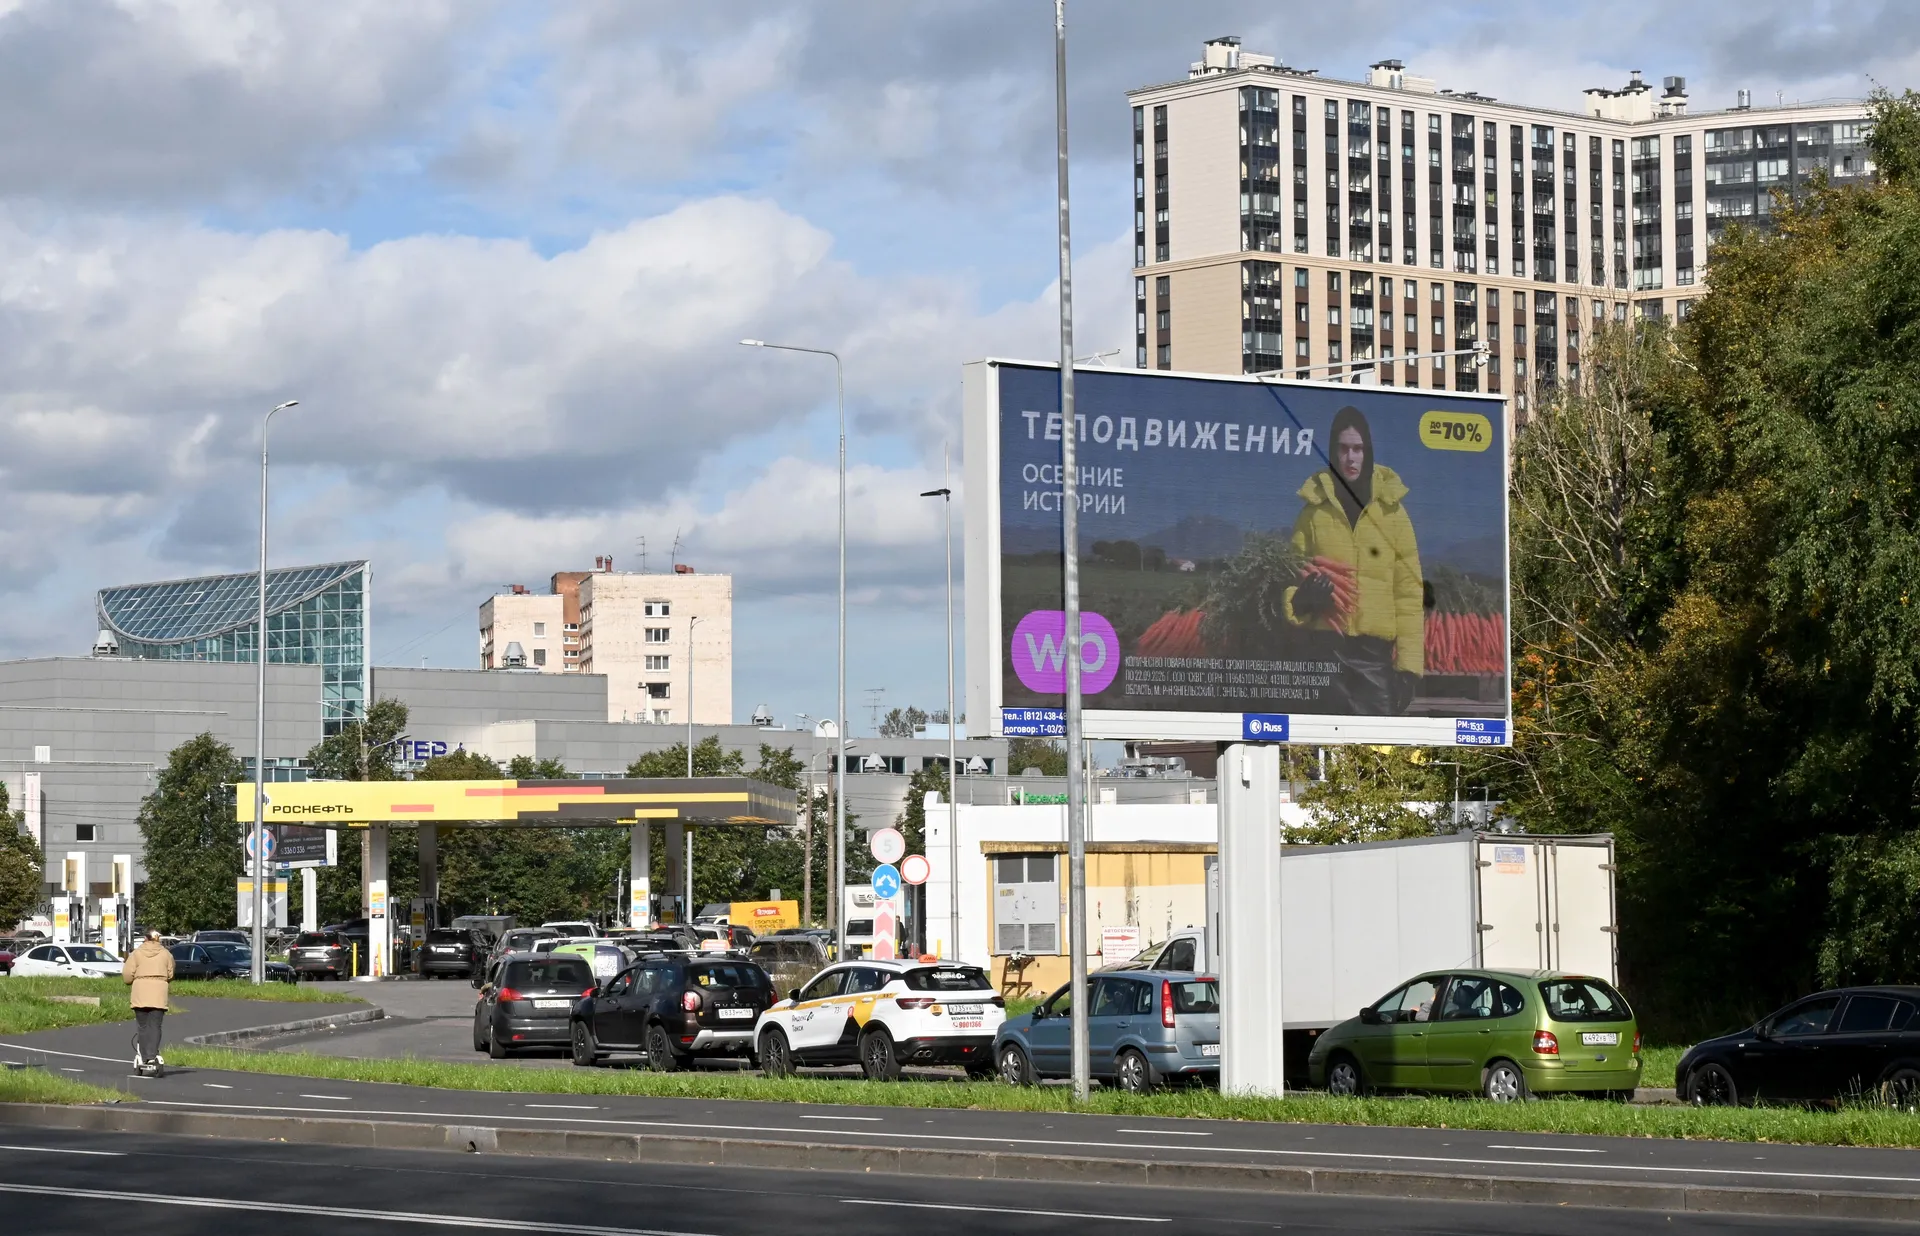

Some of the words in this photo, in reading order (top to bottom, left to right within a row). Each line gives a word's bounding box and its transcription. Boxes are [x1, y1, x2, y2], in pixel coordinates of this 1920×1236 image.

[1022, 463, 1124, 488] ОСЕНИЕ
[1164, 658, 1185, 669] ТОВАРА
[1225, 660, 1245, 670] СРОКИ
[1125, 669, 1135, 681] ПО
[1024, 711, 1042, 721] (812)
[1004, 726, 1039, 735] договор:
[1263, 721, 1283, 732] Russ
[272, 804, 354, 814] РОСНЕФТЬ
[883, 838, 894, 854] 5
